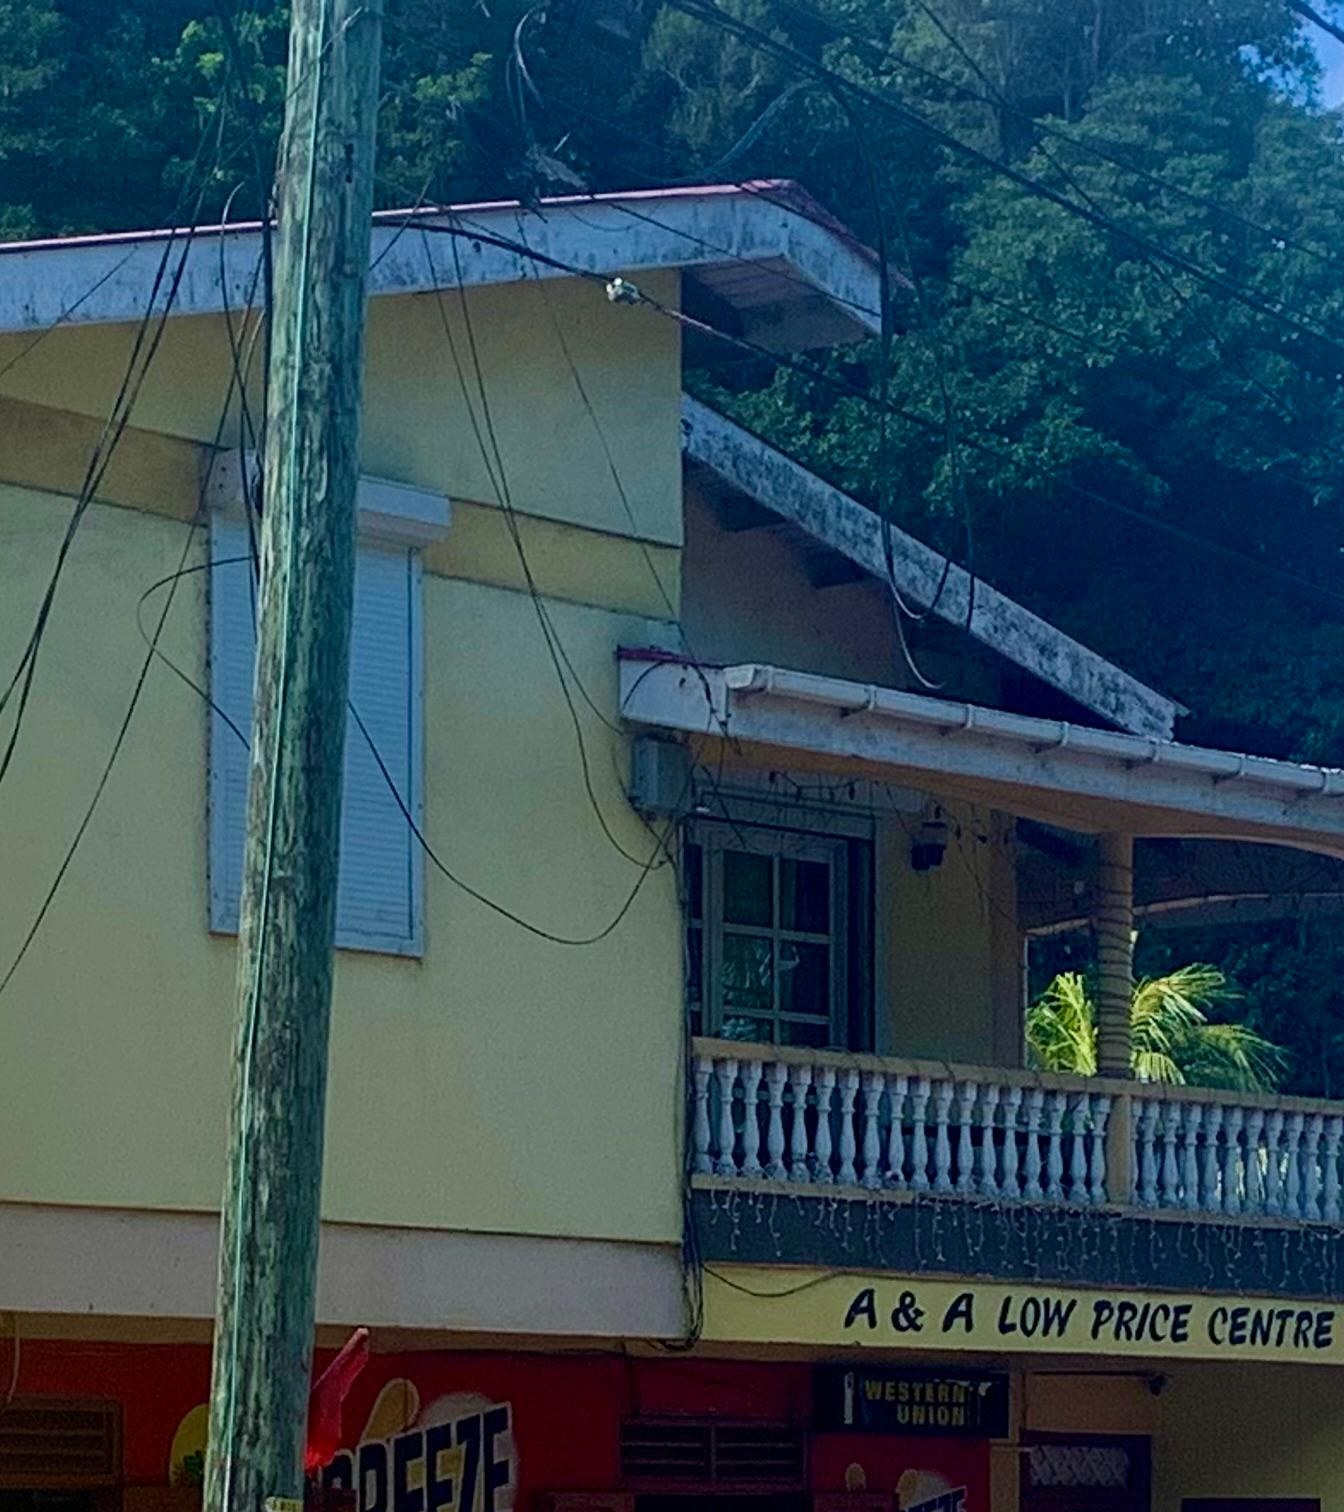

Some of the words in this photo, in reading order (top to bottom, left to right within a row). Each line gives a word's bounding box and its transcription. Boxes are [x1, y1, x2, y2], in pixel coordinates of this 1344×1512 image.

[843, 1287, 878, 1330] A
[890, 1290, 926, 1333] &
[941, 1292, 975, 1334] A
[997, 1294, 1078, 1339] LOW
[1090, 1298, 1194, 1344] PRICE
[1206, 1305, 1336, 1350] CENTRE
[864, 1378, 966, 1404] WESTERN
[895, 1403, 966, 1426] UNION
